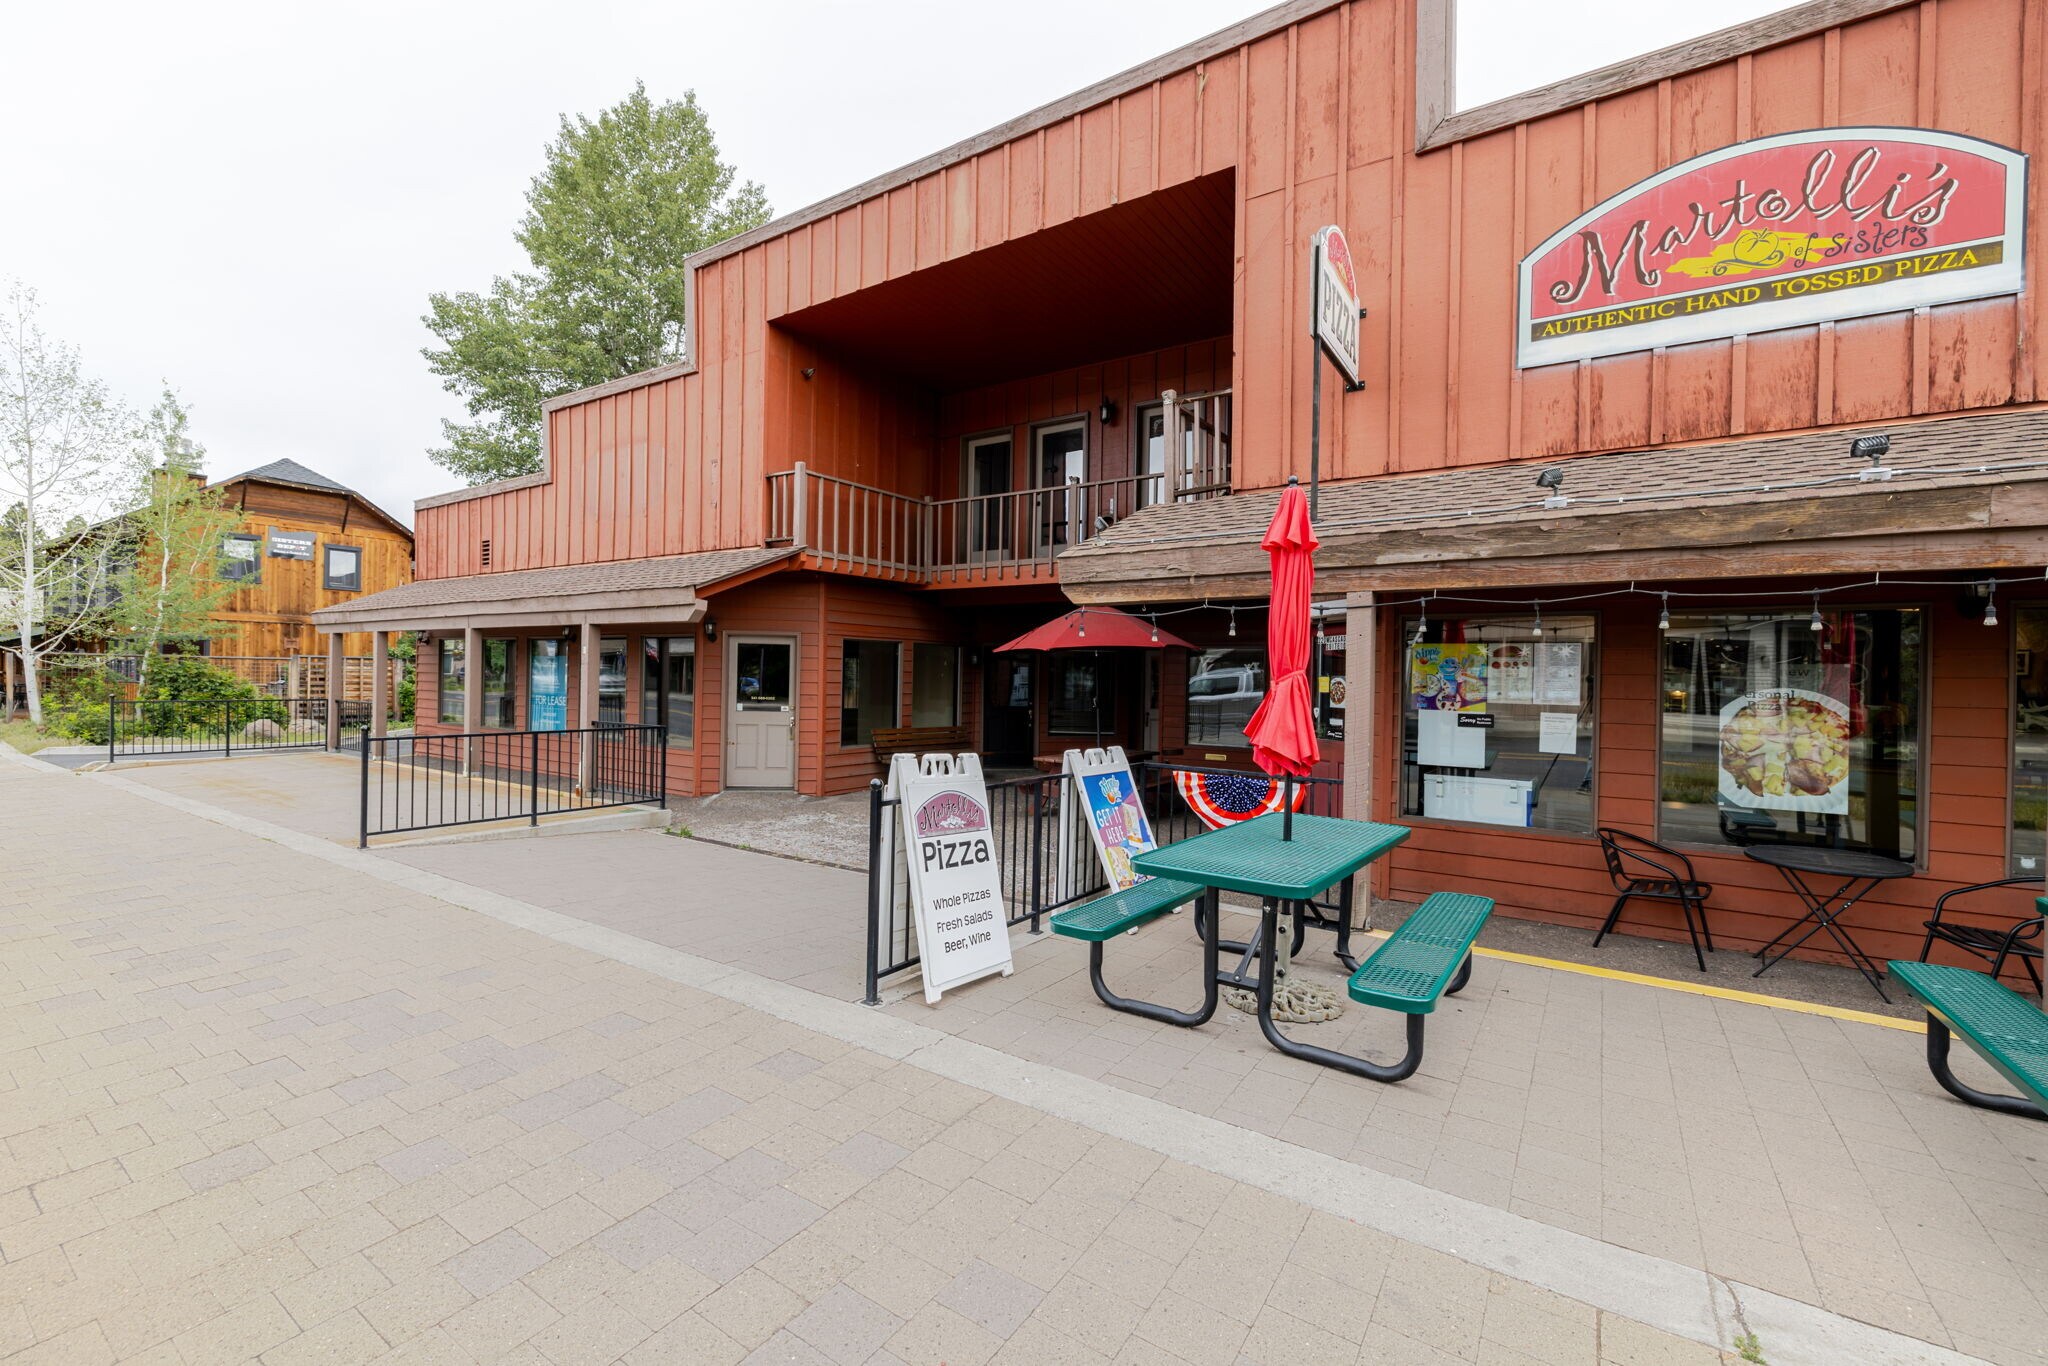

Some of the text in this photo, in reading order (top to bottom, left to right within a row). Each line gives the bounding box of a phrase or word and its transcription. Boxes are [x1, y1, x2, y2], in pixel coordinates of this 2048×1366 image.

[1550, 146, 1959, 304] Martolli's
[1794, 232, 1818, 268] of
[1541, 249, 1979, 338] AUTHENTIC HAND TOSSED PIZZA
[1323, 269, 1357, 365] PIZZA
[535, 695, 567, 706] FOR LEASE
[1744, 690, 1796, 700] ersonal
[1460, 716, 1476, 725] Sorry
[1096, 806, 1122, 828] GET IT
[1105, 825, 1124, 845] HERE
[922, 839, 990, 872] Pizza
[933, 889, 991, 910] Whole Pizzas
[936, 910, 993, 934] Fresh Salads
[944, 931, 991, 954] Beer, Wine
